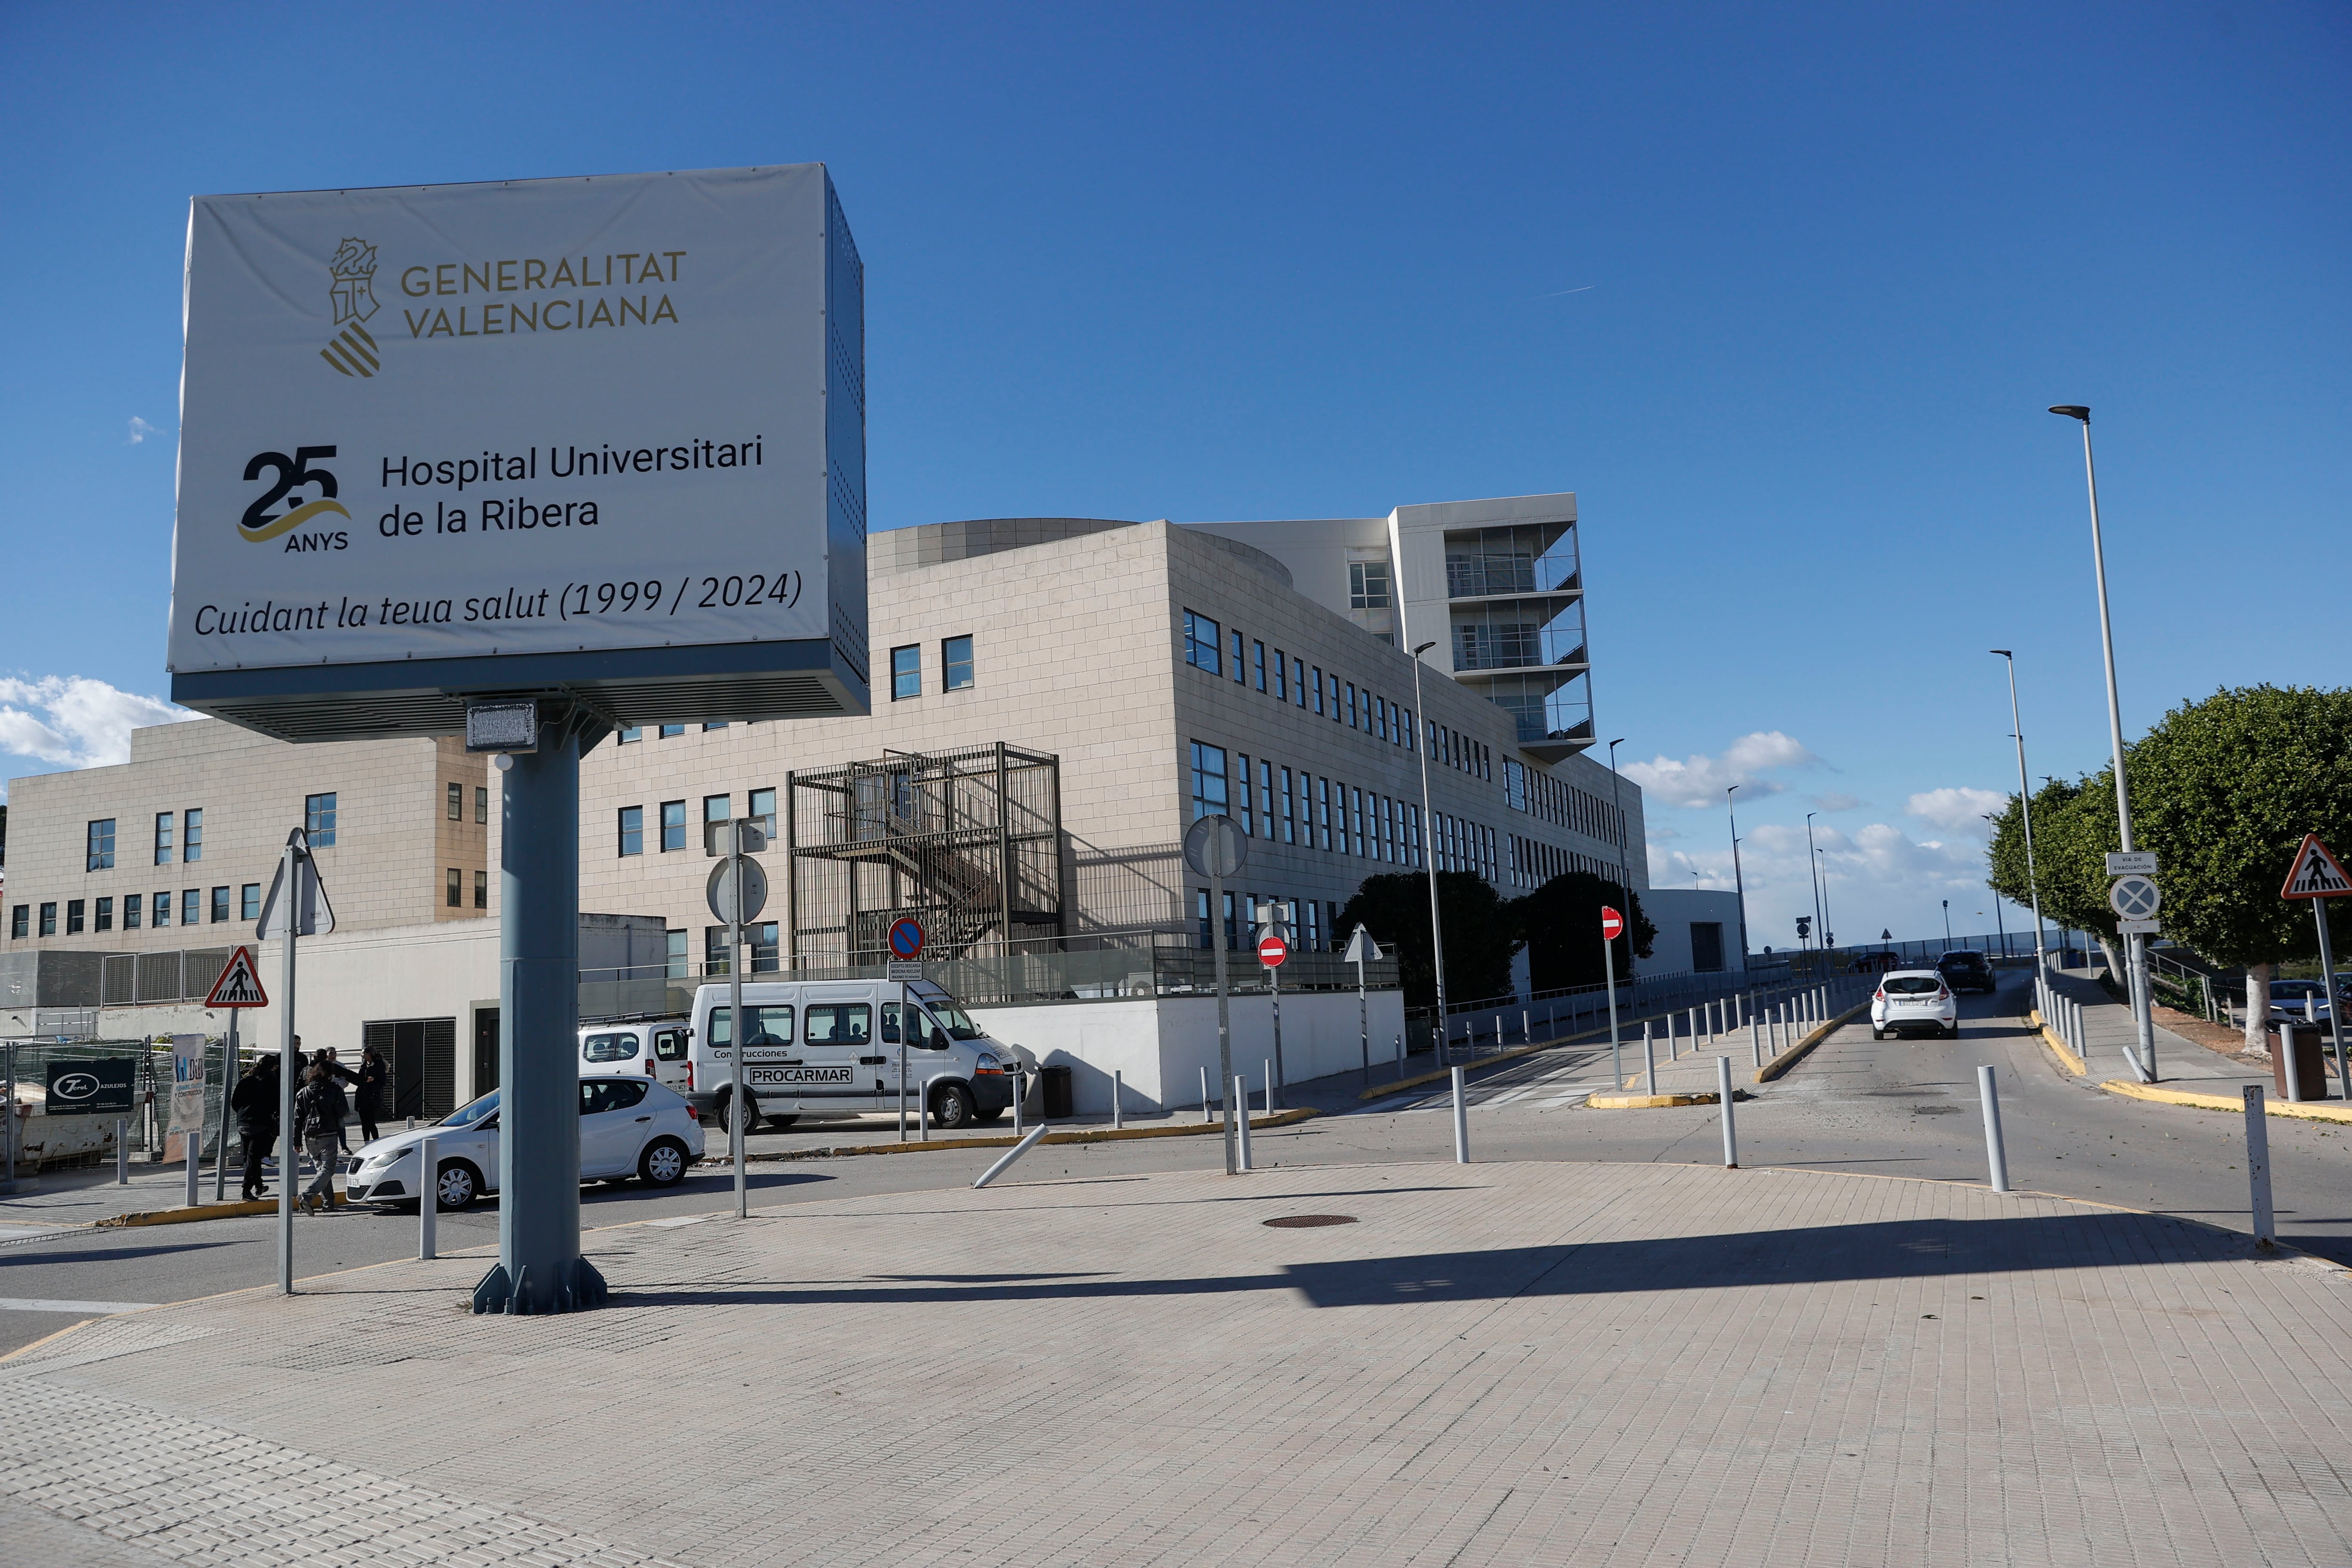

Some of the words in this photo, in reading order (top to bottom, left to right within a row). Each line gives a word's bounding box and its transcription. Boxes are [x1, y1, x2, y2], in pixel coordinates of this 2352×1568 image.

[402, 251, 686, 297] GENERALITAT
[404, 294, 678, 339] VALENCIANA
[382, 447, 536, 491] Hospital
[551, 435, 762, 478] Universitari
[241, 445, 338, 529] 25
[380, 504, 423, 537] de
[437, 501, 466, 533] la
[482, 497, 599, 532] Ribera
[285, 532, 349, 553] ANYS
[195, 600, 328, 636] Cuidant
[338, 597, 368, 628] la
[380, 597, 452, 627] teua
[463, 587, 549, 621] salut
[560, 580, 662, 621] (1999
[669, 577, 689, 615] /
[698, 570, 802, 610] 2024)
[714, 1049, 787, 1058] Conrucciones
[65, 1079, 88, 1093] Terol
[752, 1069, 850, 1082] PROCARMAR
